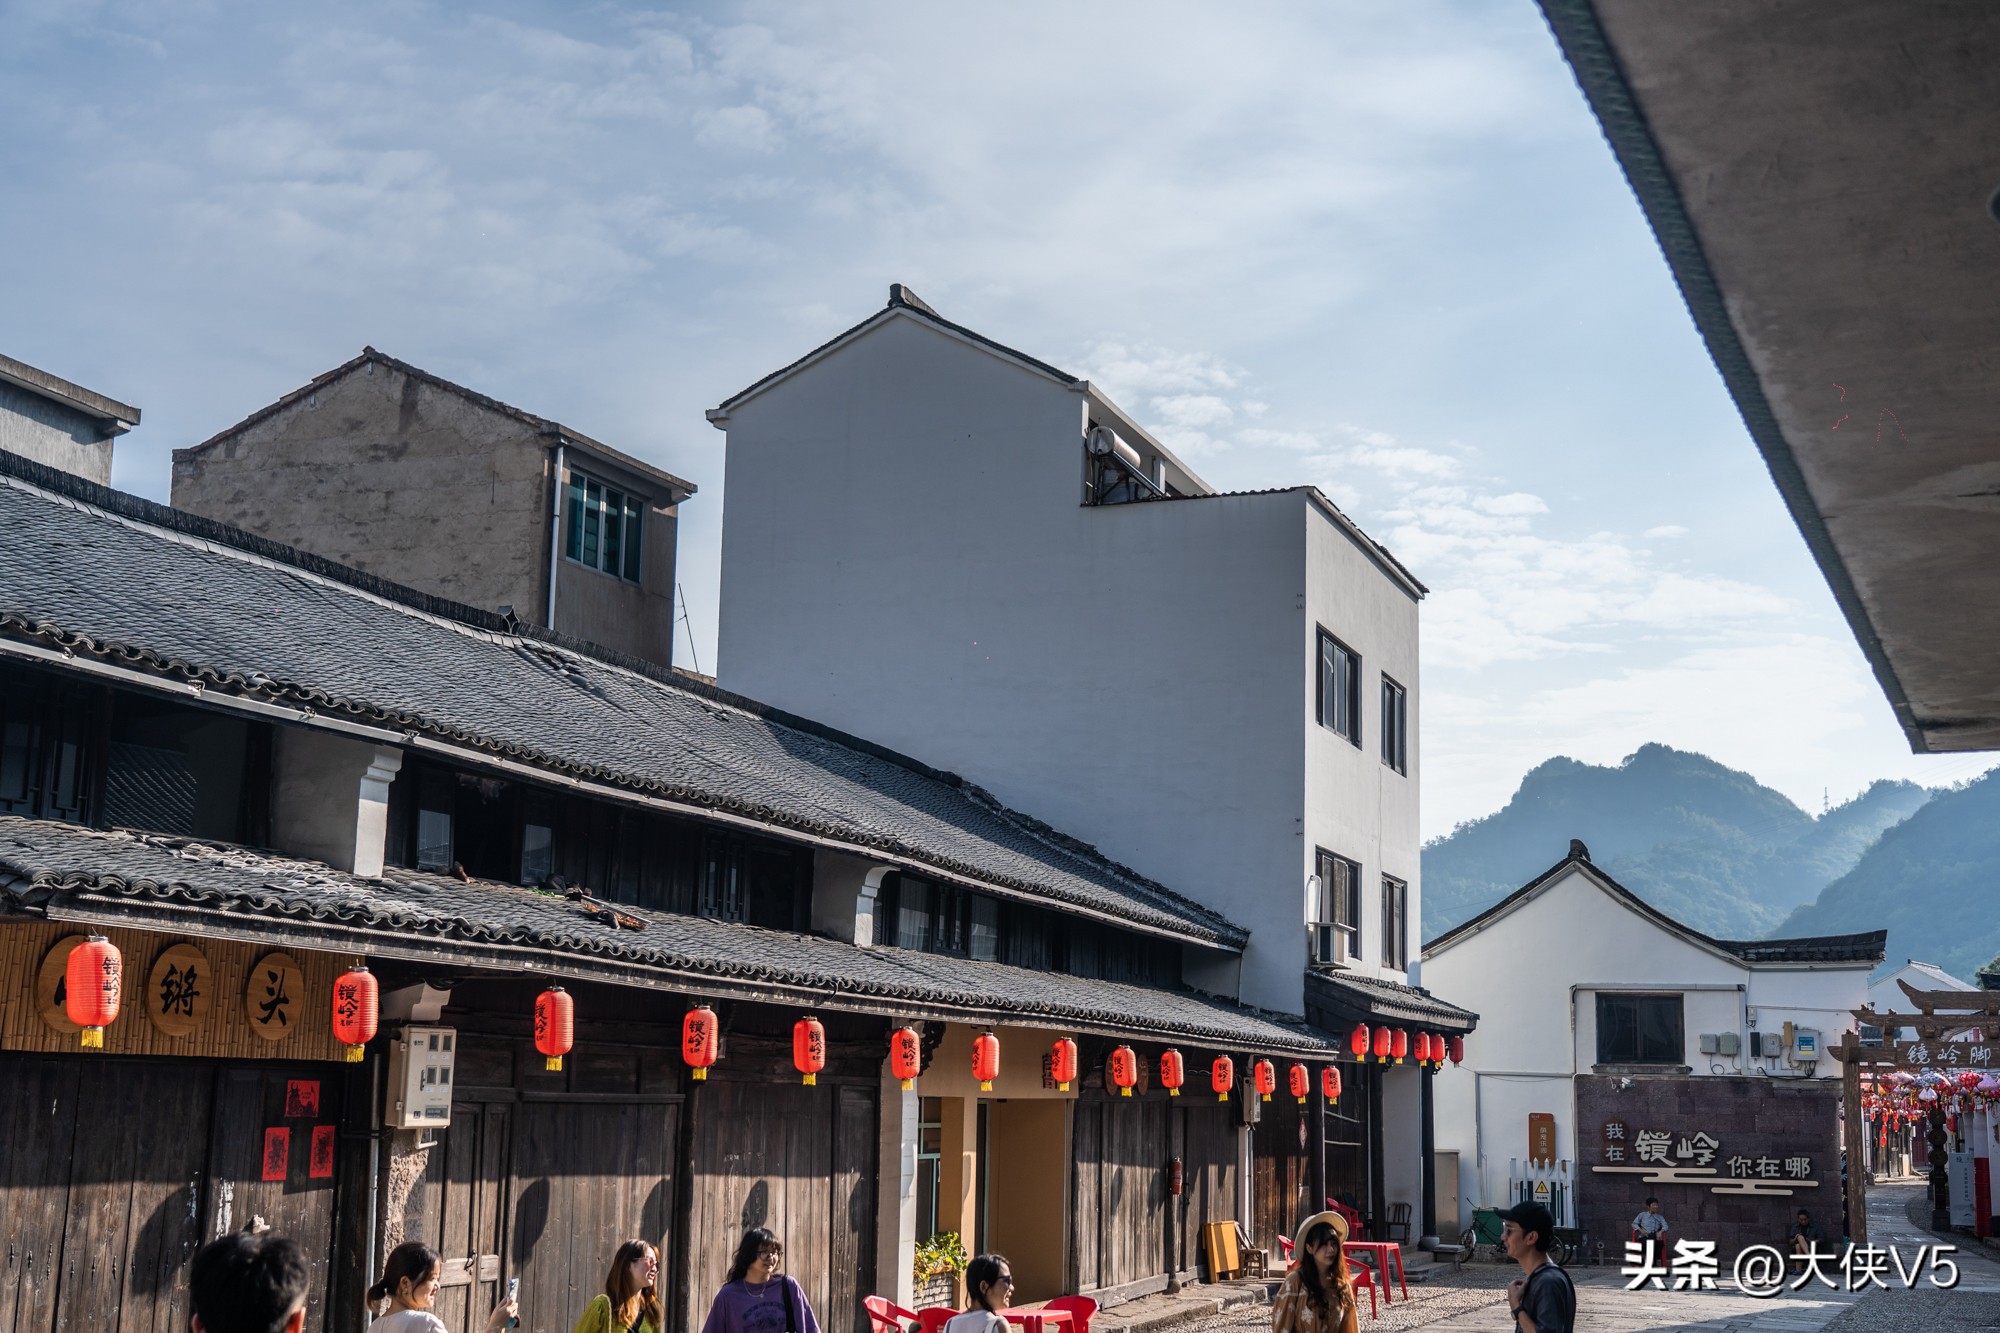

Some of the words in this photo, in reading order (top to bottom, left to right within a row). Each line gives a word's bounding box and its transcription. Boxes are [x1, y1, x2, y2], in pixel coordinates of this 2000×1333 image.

[1605, 1122, 1625, 1162] 我在
[1634, 1129, 1719, 1167] 镜岭
[1726, 1155, 1811, 1178] 你在哪
